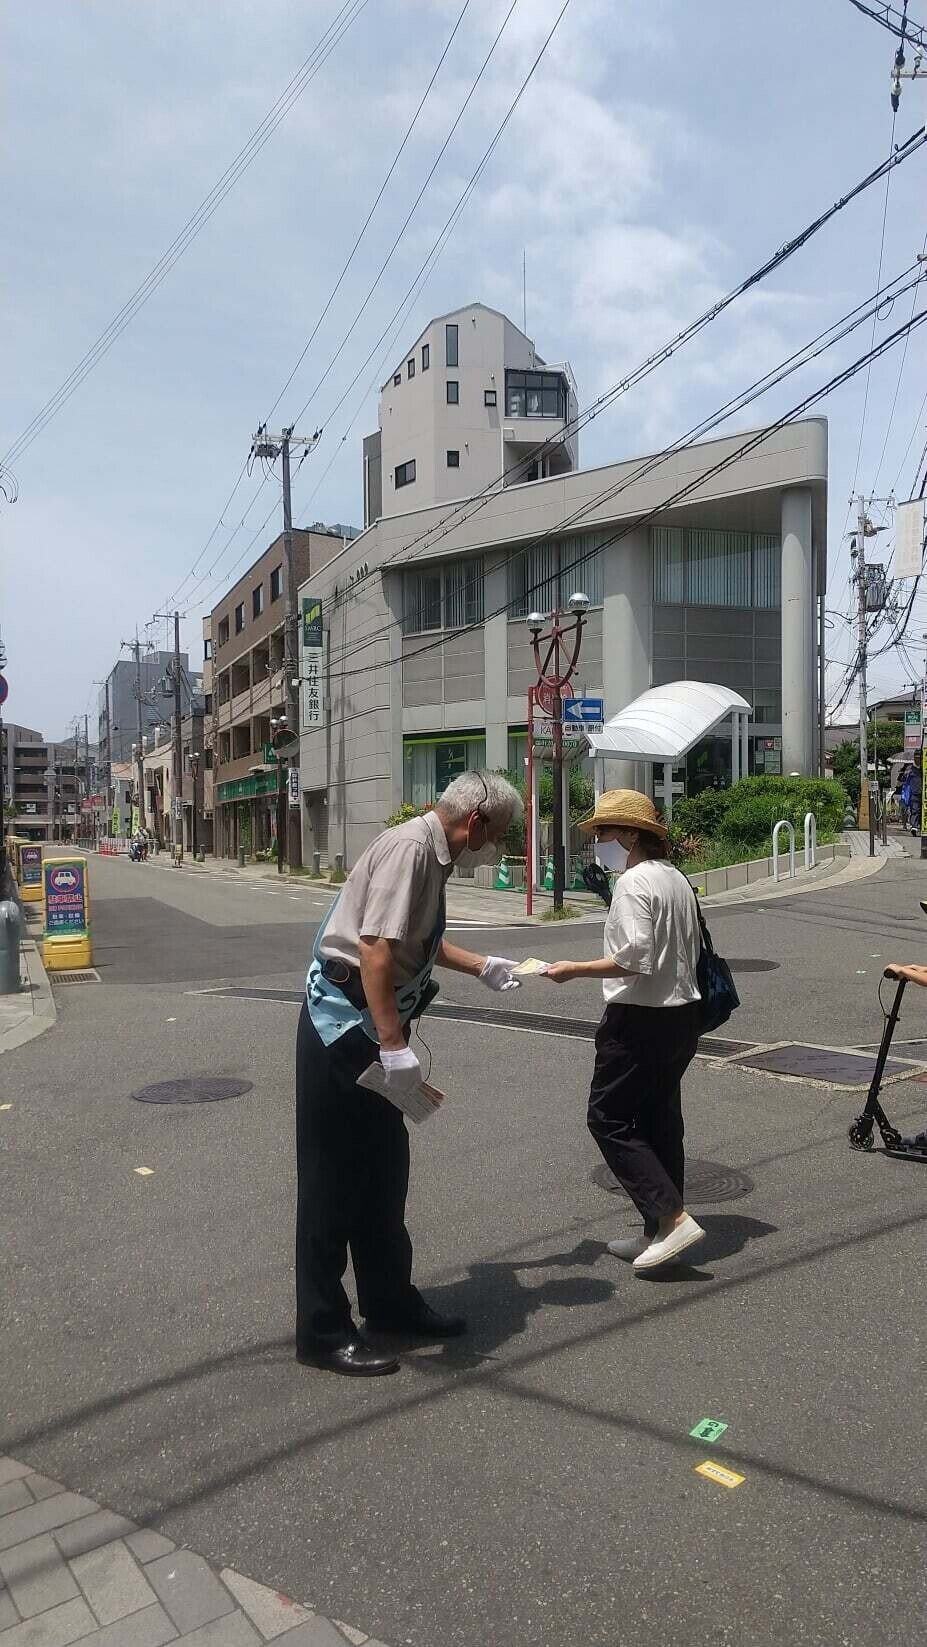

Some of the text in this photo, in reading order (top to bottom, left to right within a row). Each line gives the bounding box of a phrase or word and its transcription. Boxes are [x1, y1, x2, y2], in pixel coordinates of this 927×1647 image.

[308, 652, 320, 721] 三井住友銀行
